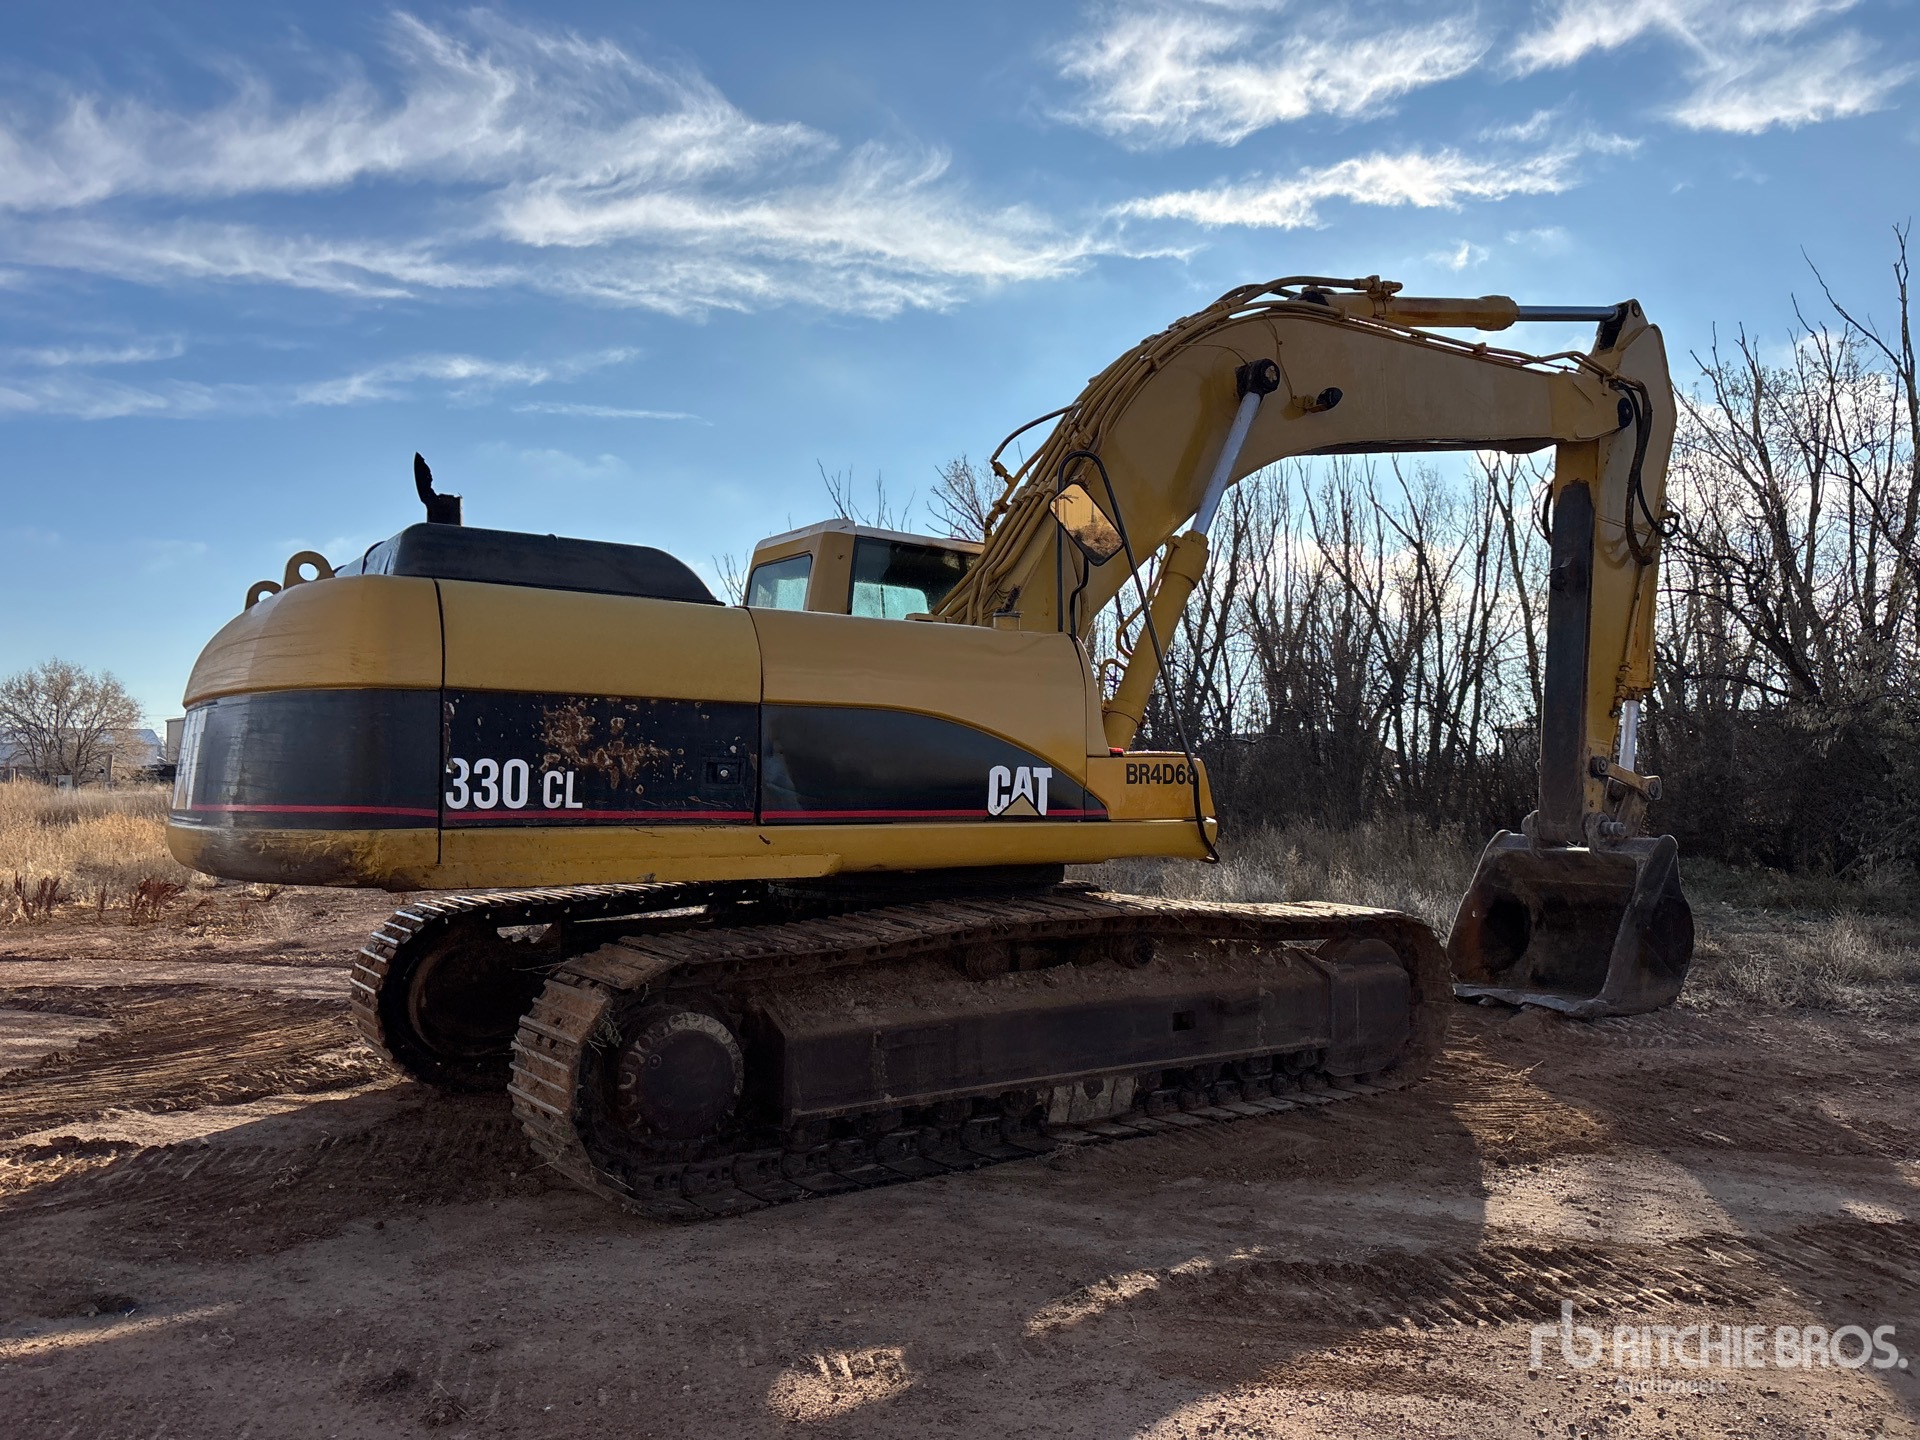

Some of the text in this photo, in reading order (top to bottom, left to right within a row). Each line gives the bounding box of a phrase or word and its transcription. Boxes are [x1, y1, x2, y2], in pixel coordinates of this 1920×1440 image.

[445, 757, 584, 810] 330 CL
[988, 765, 1053, 816] CAT
[1126, 763, 1196, 785] BR4D68
